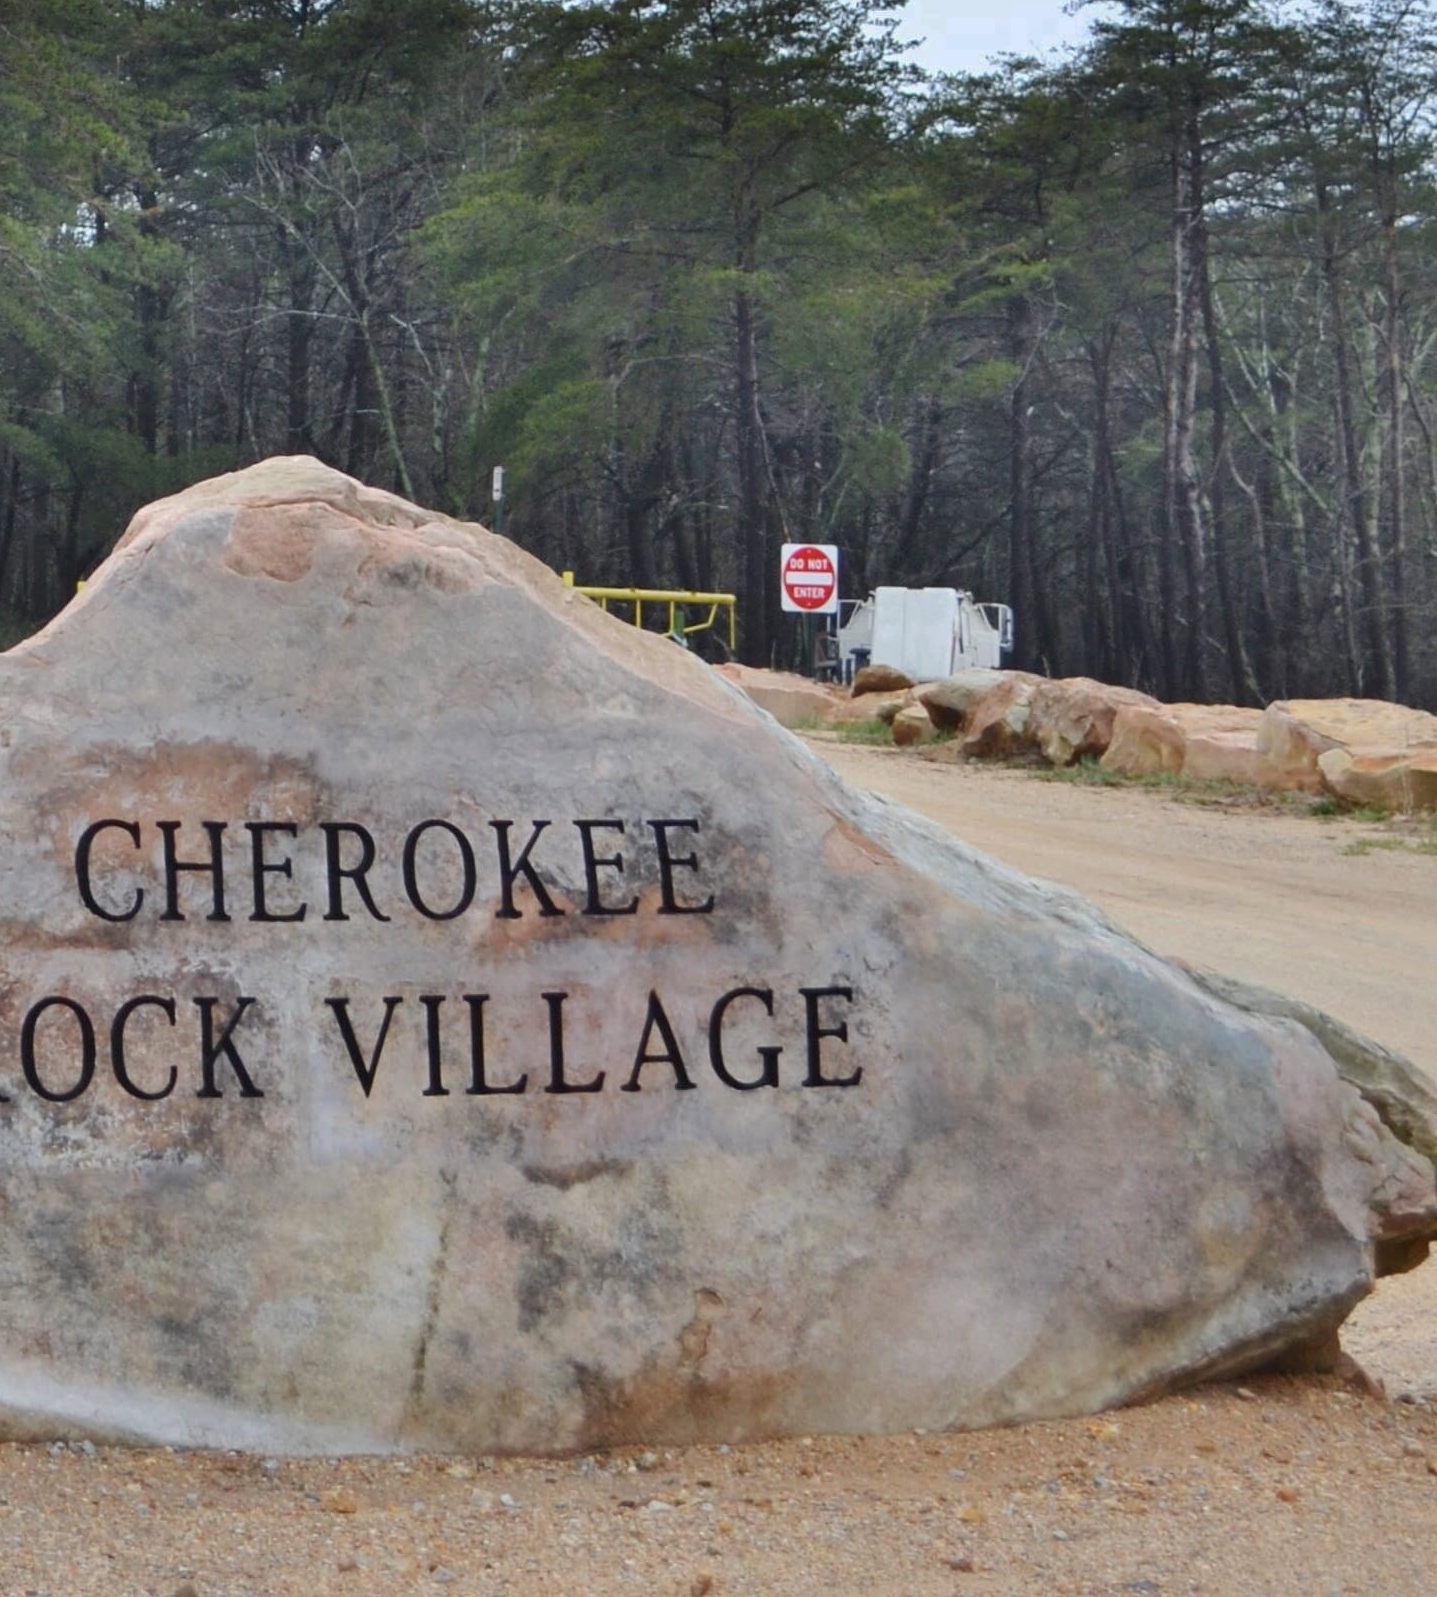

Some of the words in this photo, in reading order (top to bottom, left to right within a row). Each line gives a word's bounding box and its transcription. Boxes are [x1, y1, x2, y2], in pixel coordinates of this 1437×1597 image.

[790, 558, 805, 570] DO
[807, 558, 828, 570] NOT
[793, 586, 825, 600] ENTER
[74, 818, 716, 924] CHEROKEE
[324, 985, 863, 1099] VILLAGE
